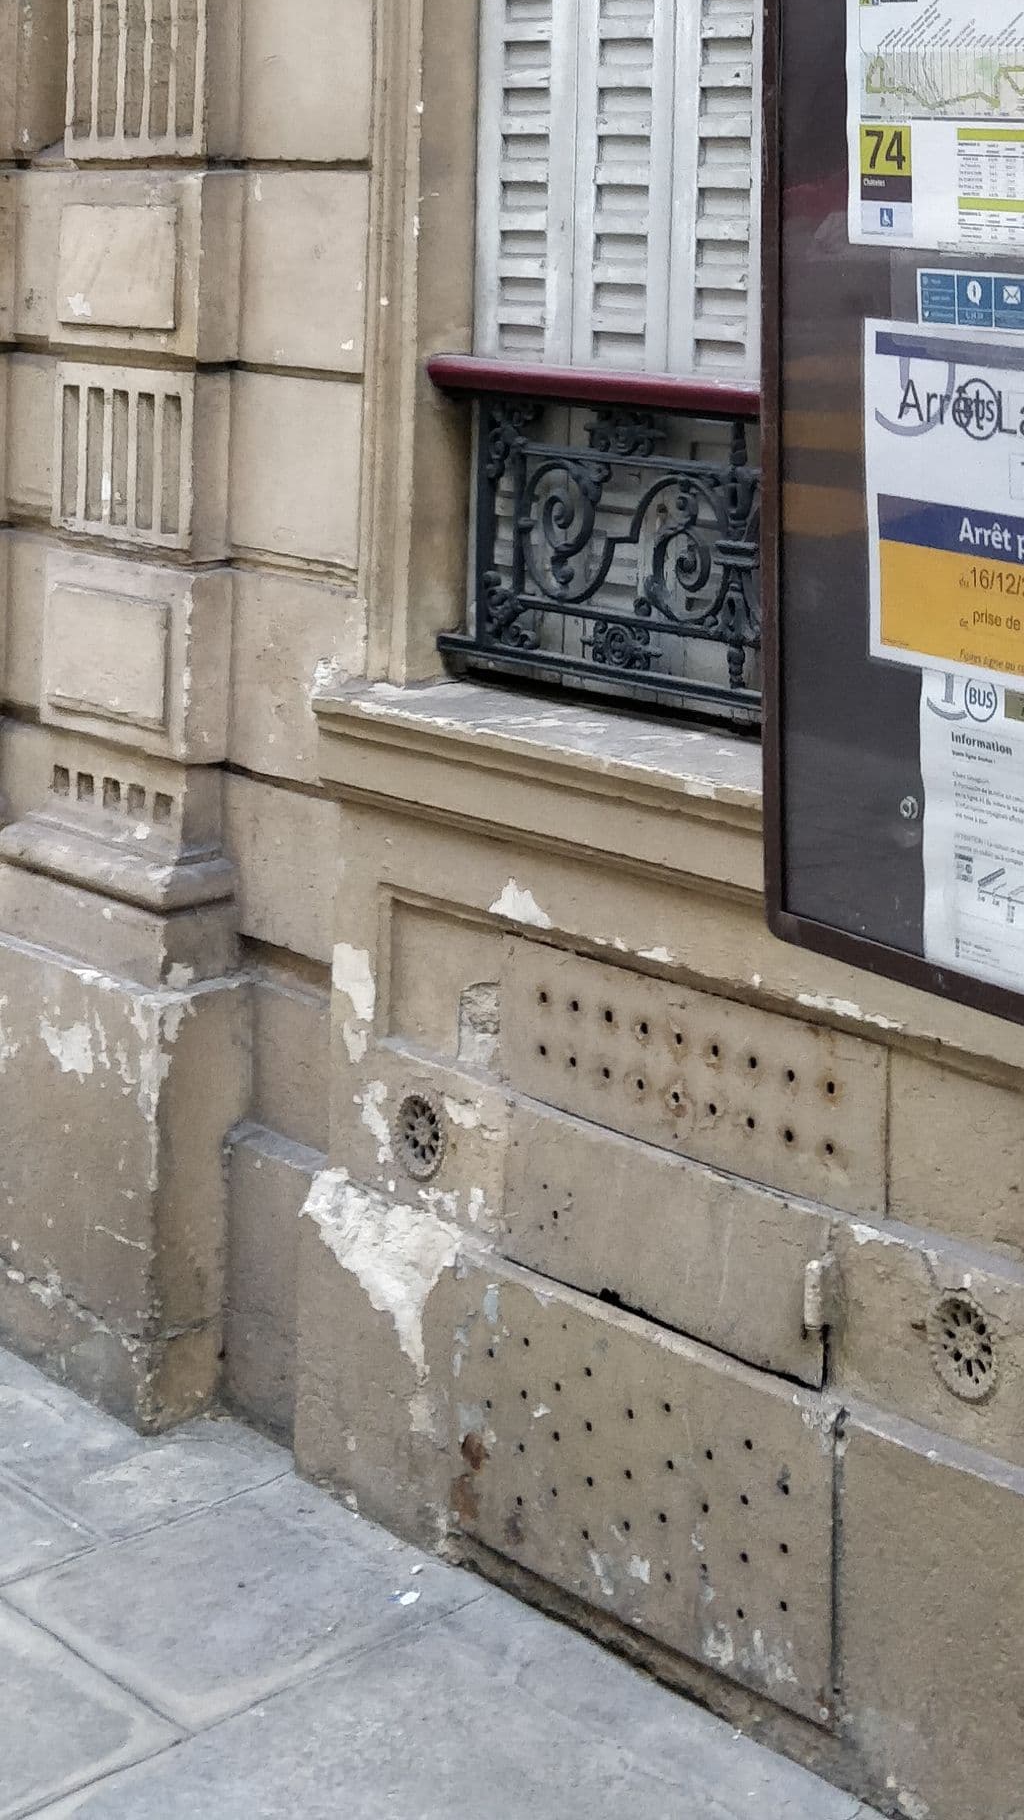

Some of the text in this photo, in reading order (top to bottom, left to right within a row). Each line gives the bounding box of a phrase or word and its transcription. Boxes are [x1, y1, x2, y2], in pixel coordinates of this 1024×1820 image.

[865, 129, 906, 170] 74
[958, 517, 1012, 552] Arrêt
[973, 608, 1002, 627] prise
[1005, 615, 1021, 631] de
[968, 686, 994, 709] BUS
[951, 731, 1013, 756] Information
